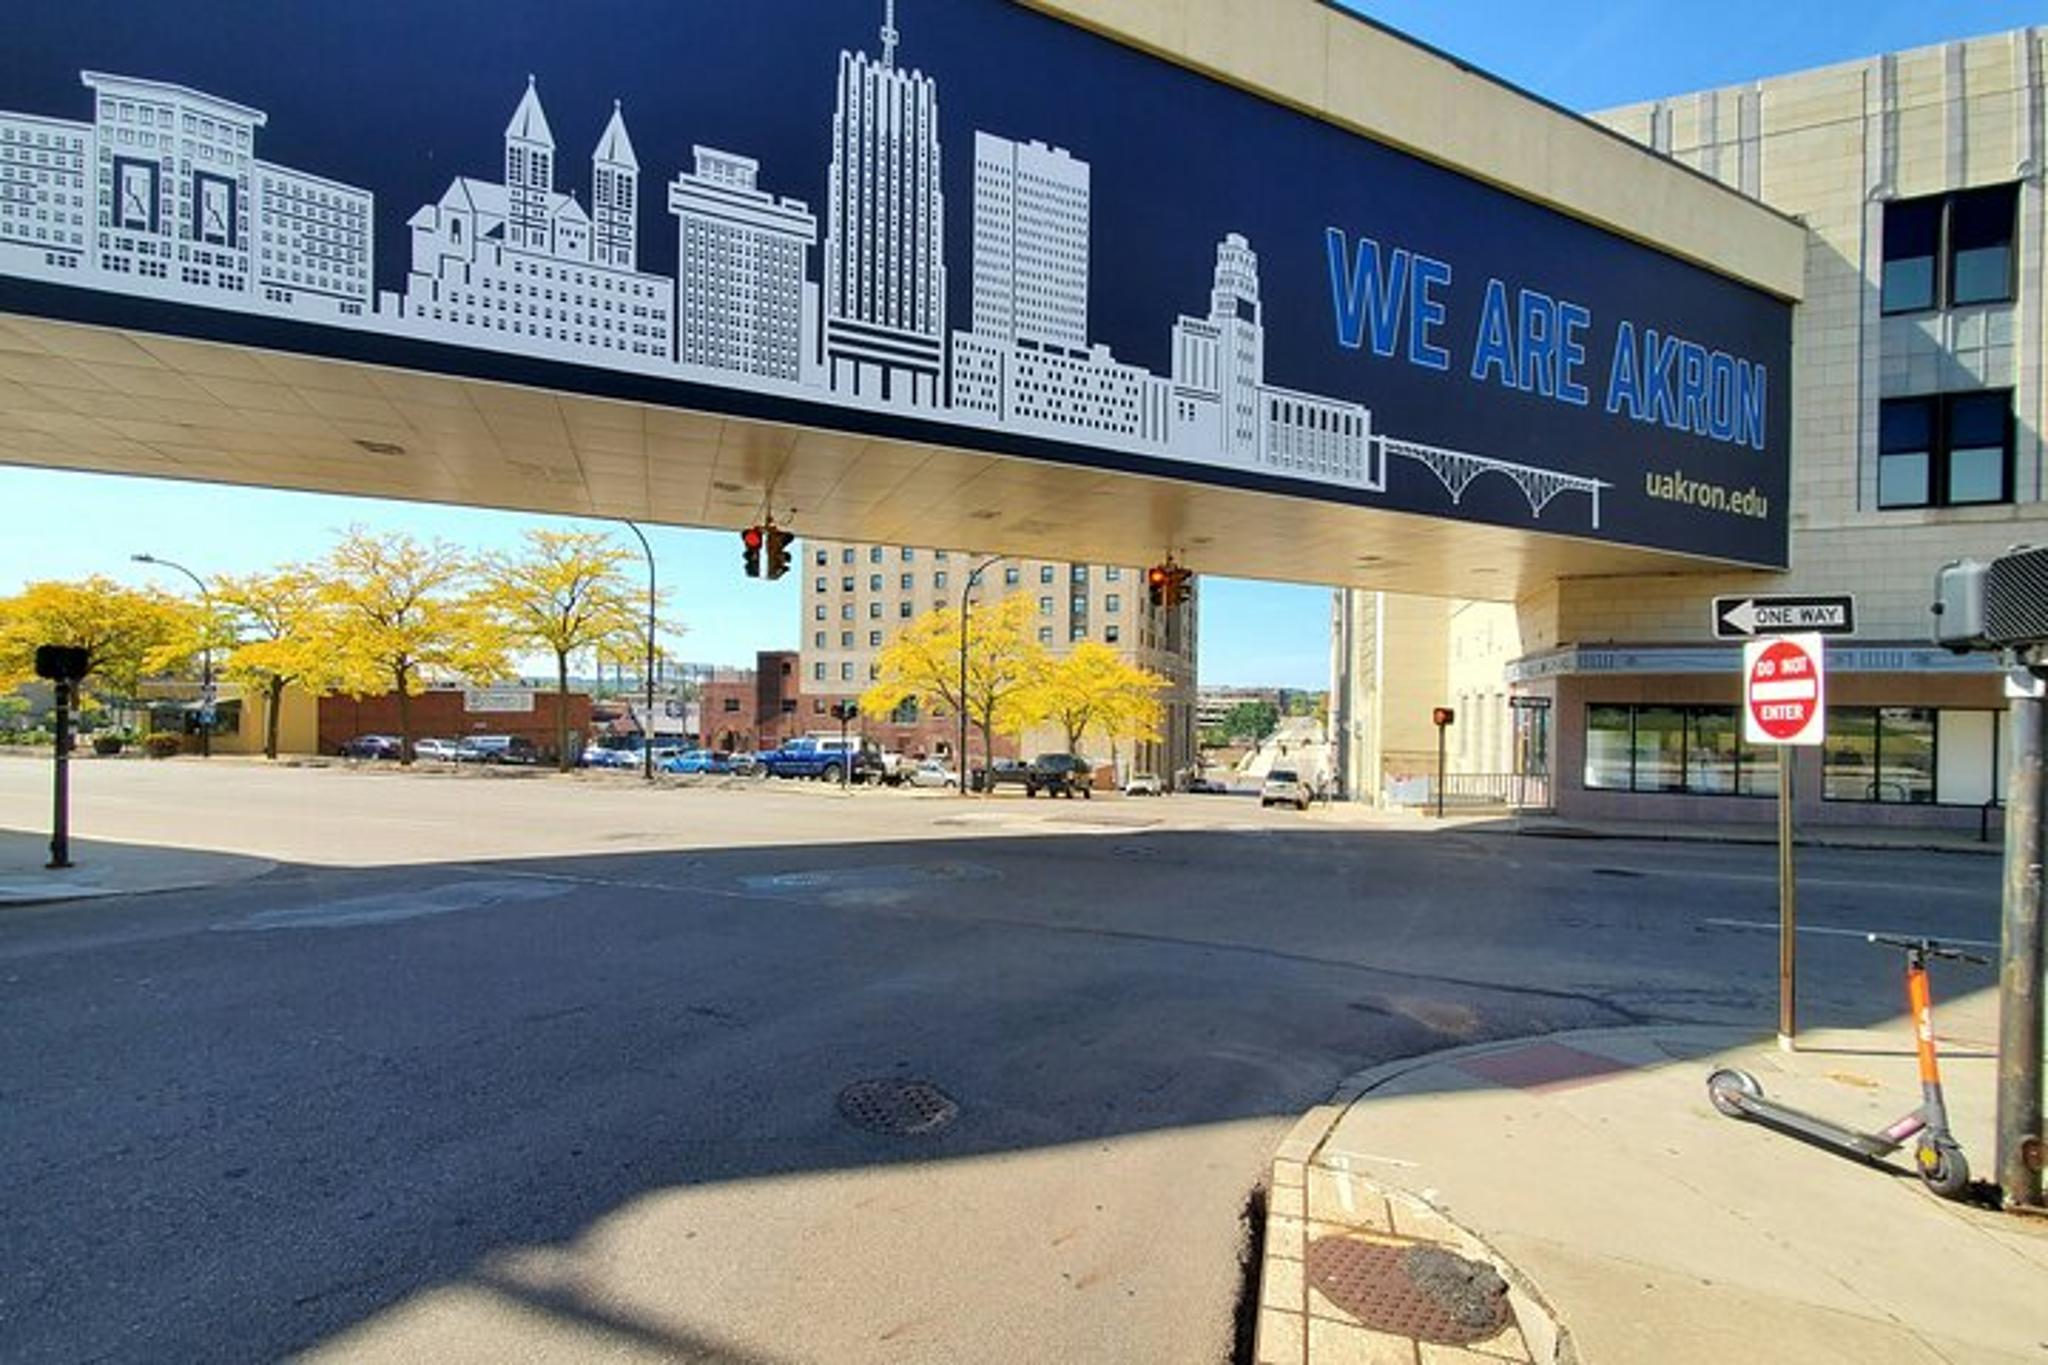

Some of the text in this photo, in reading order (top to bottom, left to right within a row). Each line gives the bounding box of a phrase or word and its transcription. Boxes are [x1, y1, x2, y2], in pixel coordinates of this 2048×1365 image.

[1325, 227, 1768, 450] WE ARE AKRON
[1646, 470, 1768, 519] uakron.edu
[1757, 607, 1838, 624] ONE WAY
[1757, 656, 1808, 677] DO NOT
[1761, 704, 1804, 721] ENTER
